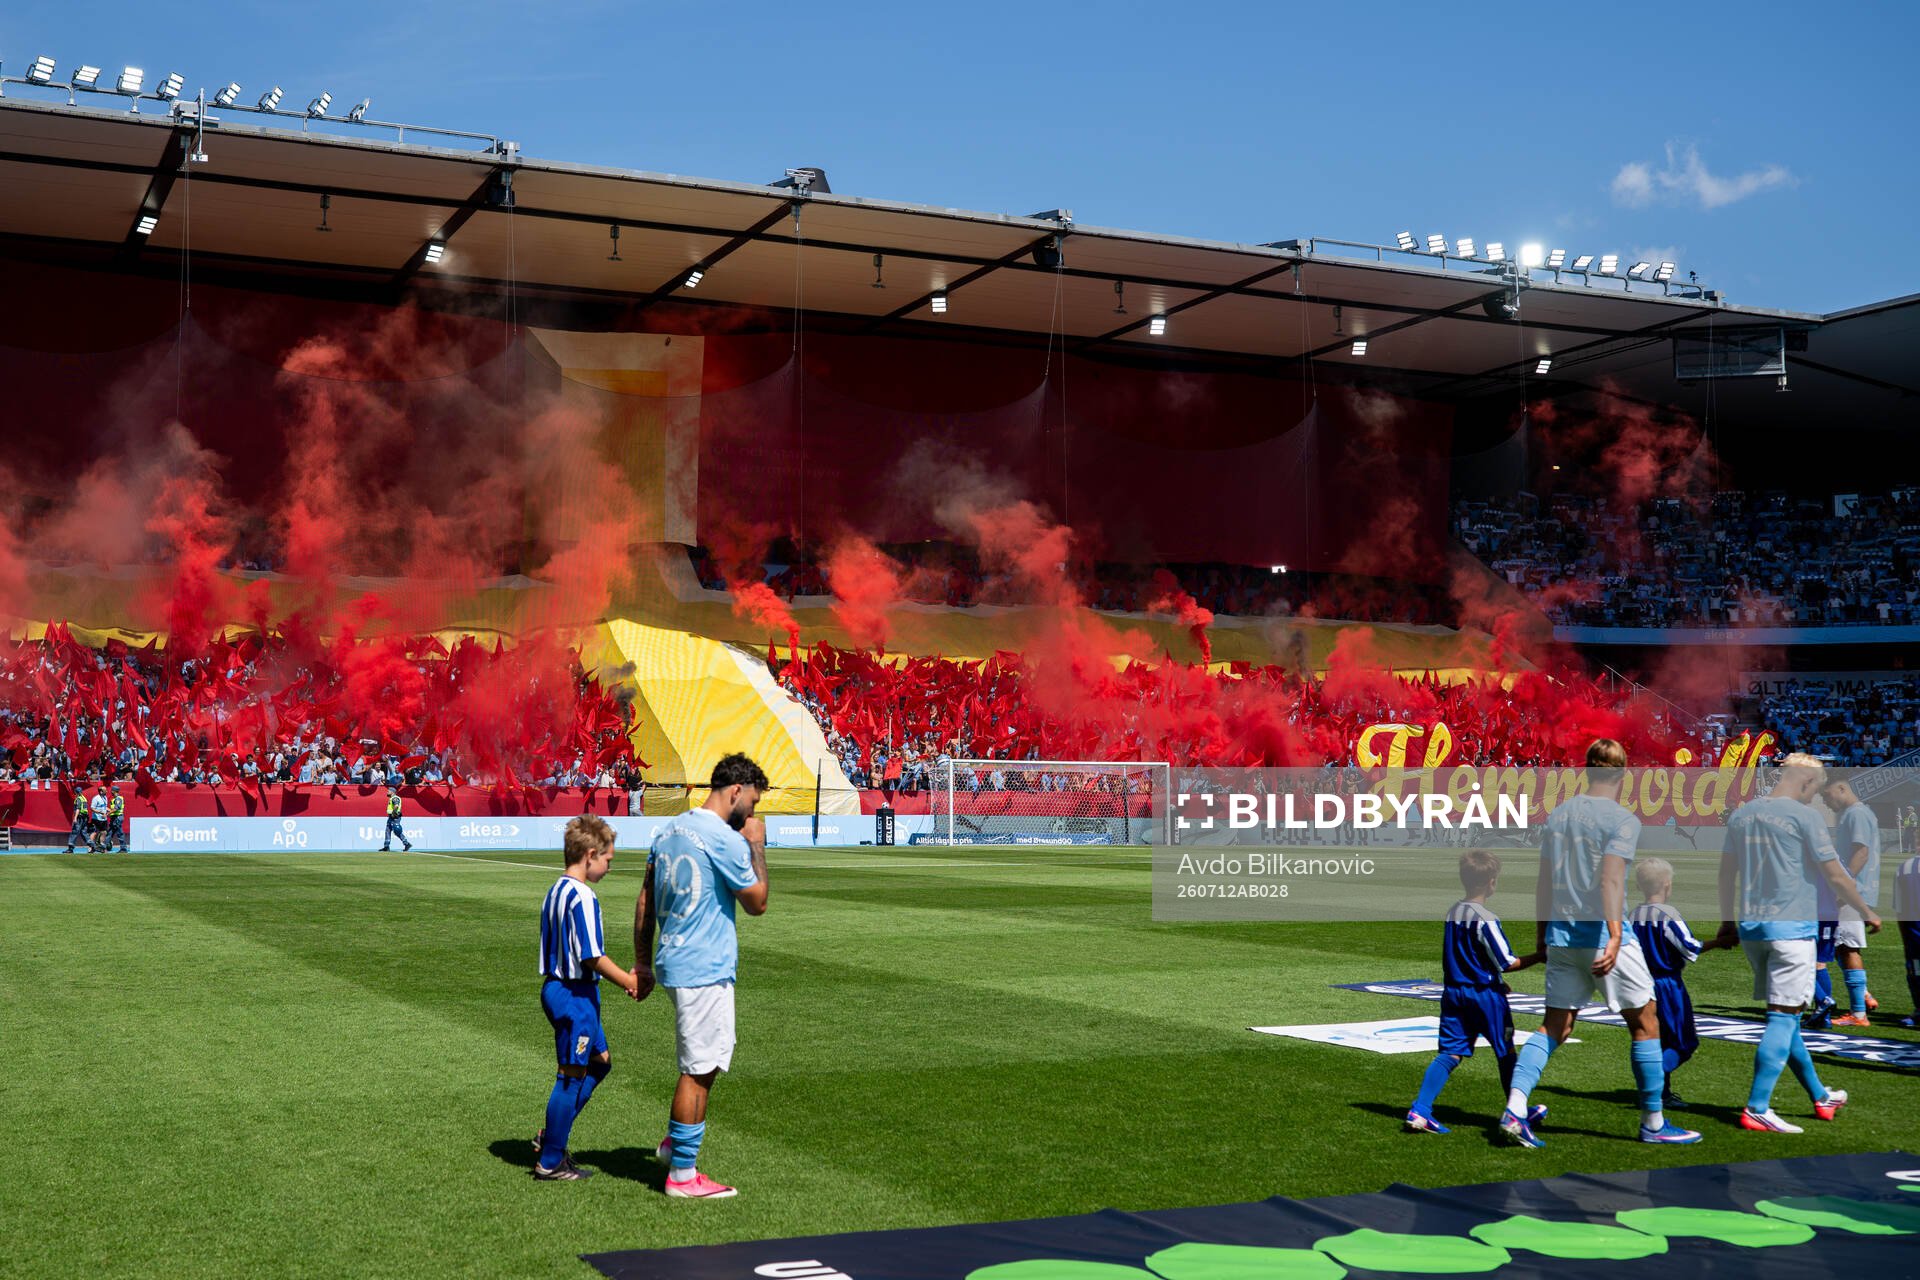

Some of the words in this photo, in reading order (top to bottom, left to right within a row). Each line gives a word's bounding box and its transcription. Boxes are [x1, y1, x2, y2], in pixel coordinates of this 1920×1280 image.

[173, 826, 218, 842] bemt
[459, 821, 502, 837] akea
[885, 816, 893, 844] SELECT
[272, 830, 308, 848] ApQ
[935, 837, 958, 845] lägsa
[959, 837, 973, 845] pris
[655, 852, 703, 919] 29
